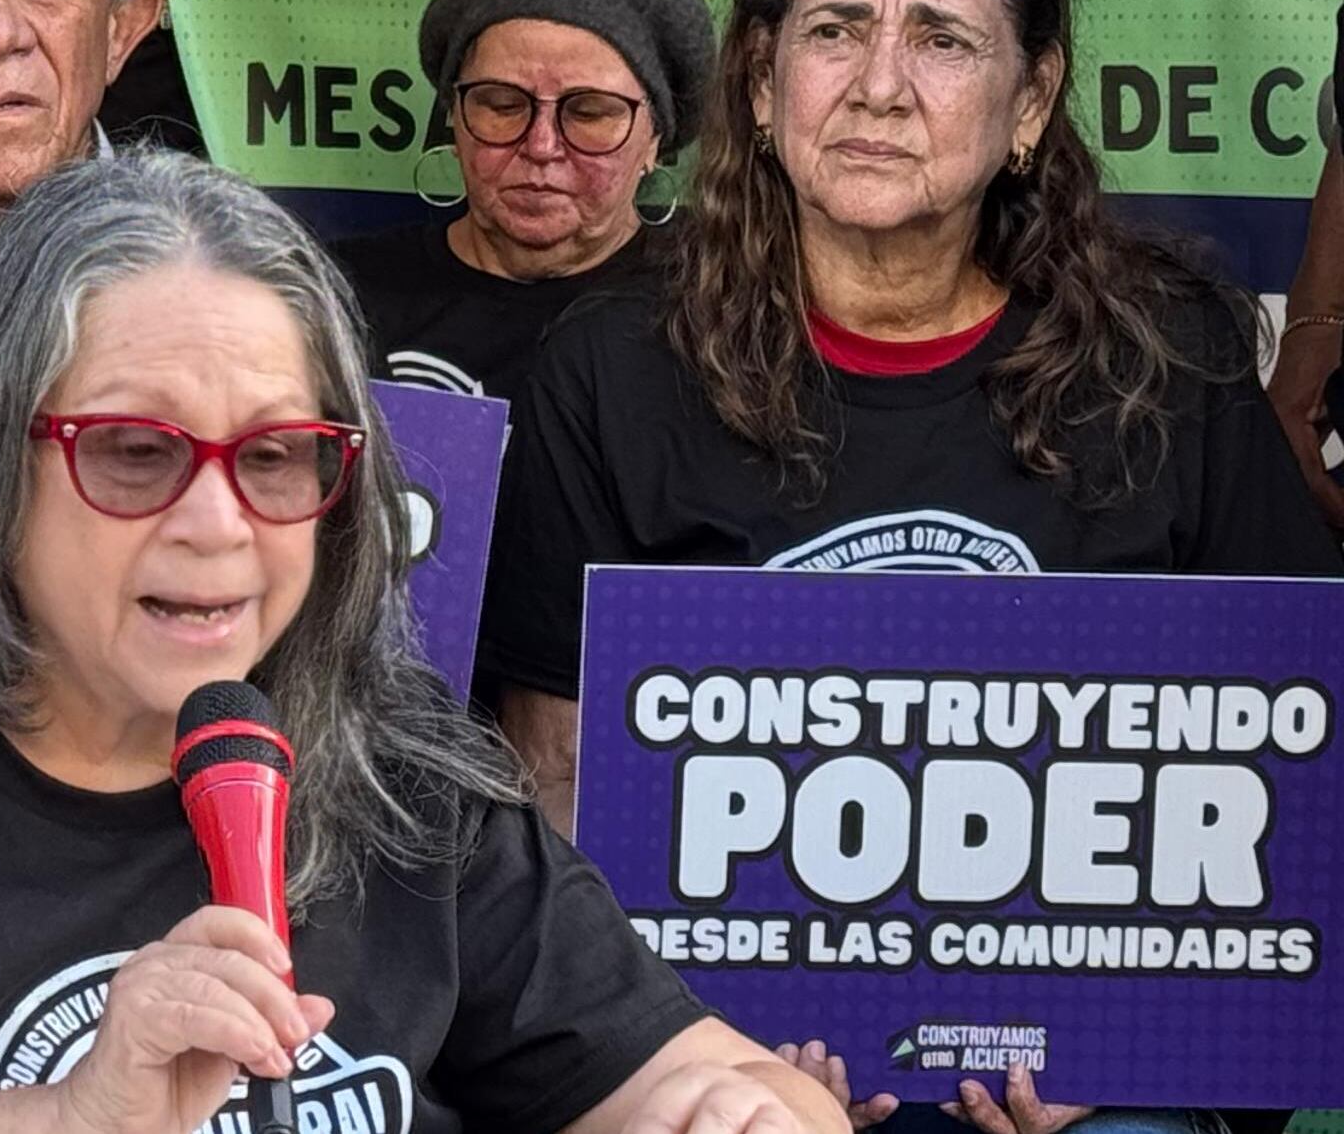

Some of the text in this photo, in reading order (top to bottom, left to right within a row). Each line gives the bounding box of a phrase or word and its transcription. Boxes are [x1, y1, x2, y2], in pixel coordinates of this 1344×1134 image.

[1101, 64, 1219, 154] DE
[912, 526, 963, 550] OTRO
[634, 675, 1327, 754] CONSTRUYENDO
[678, 755, 1270, 908] PODER
[809, 921, 912, 966] LAS
[929, 922, 1313, 973] COMUNIDADES
[918, 1024, 1046, 1047] CONSTRUYAMOS
